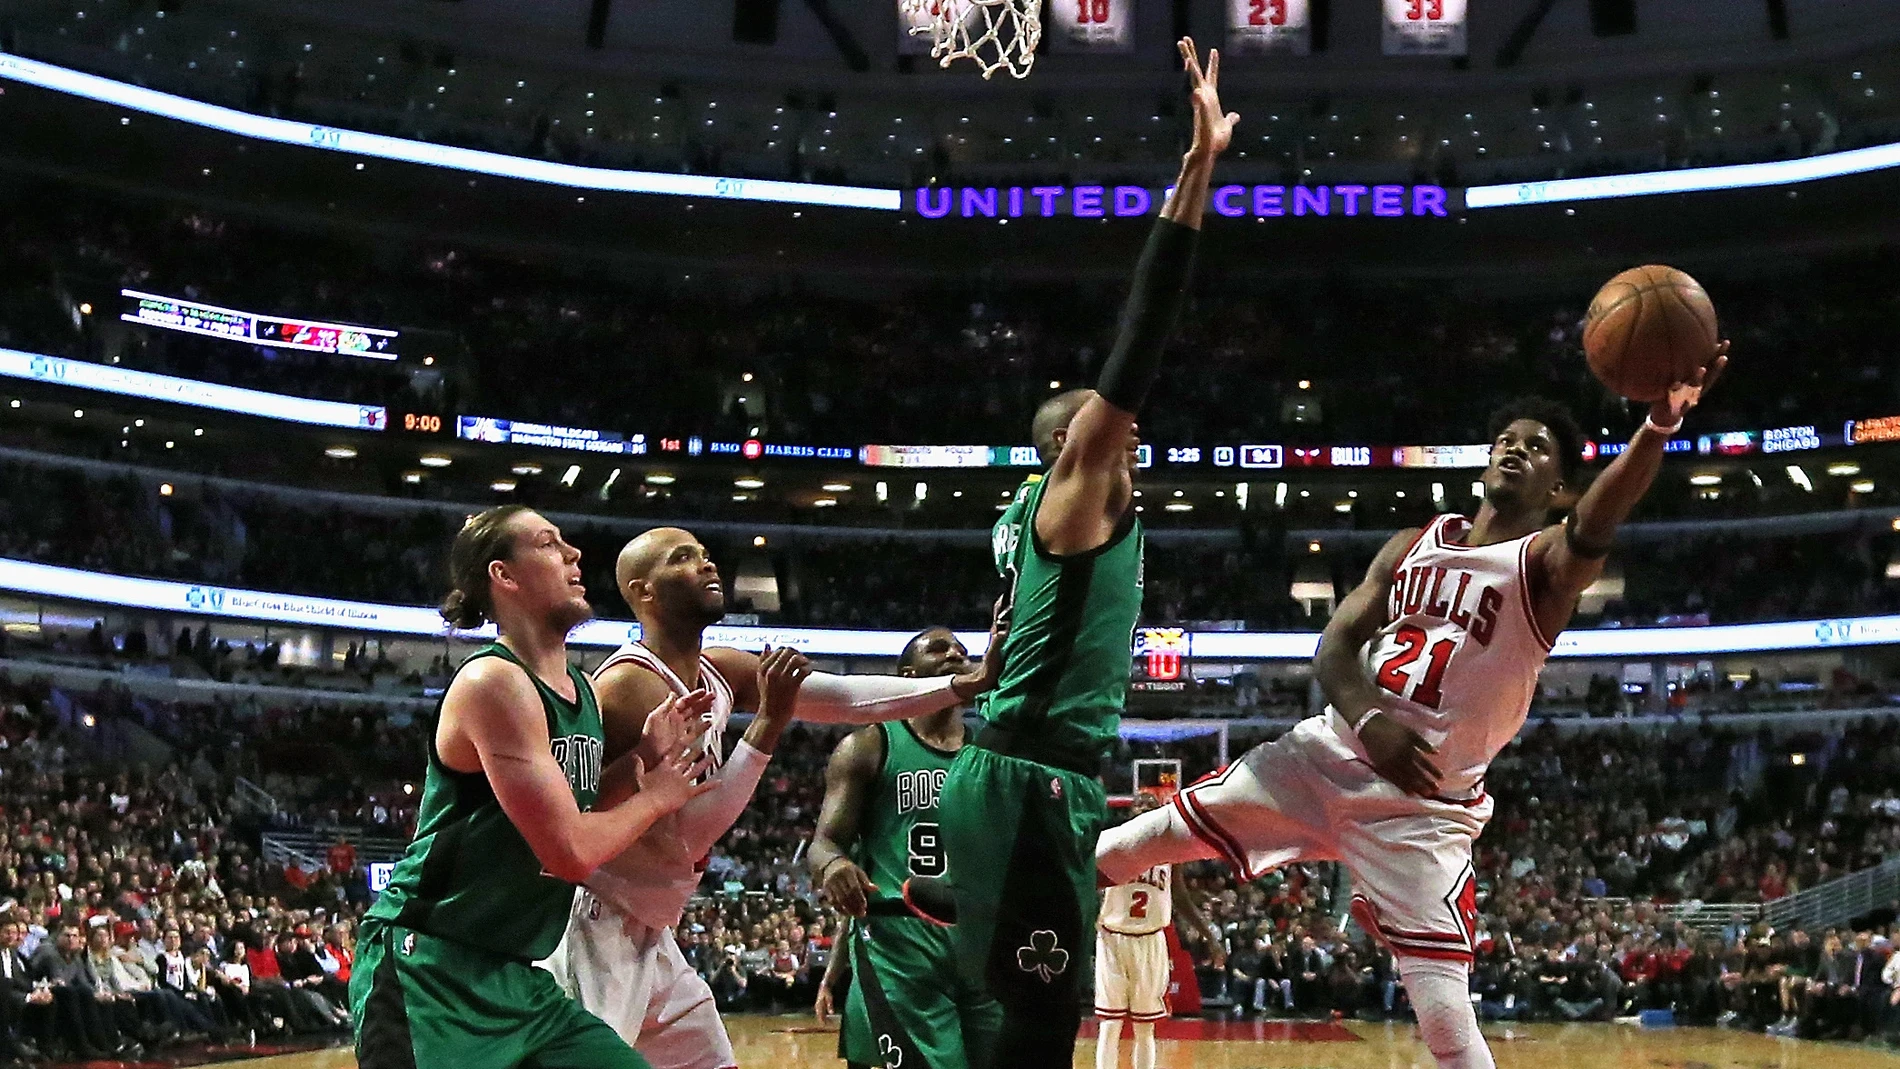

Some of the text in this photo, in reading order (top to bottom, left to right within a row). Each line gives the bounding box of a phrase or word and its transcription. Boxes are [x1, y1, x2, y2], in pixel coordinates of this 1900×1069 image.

[1077, 0, 1109, 23] 10
[1248, 0, 1287, 25] 23
[916, 185, 1448, 218] UNITED CENTER
[405, 413, 441, 432] 9:00
[1763, 426, 1815, 440] BOSTON
[660, 438, 680, 451] 1st
[711, 441, 852, 458] BMO HARRIS CLUB
[1167, 447, 1200, 463] 3:25
[1762, 436, 1820, 453] CHICAGO
[1252, 448, 1272, 463] 94
[1331, 447, 1370, 466] BULLS
[1393, 566, 1503, 648] BULLS
[1148, 650, 1180, 680] 10
[1377, 625, 1457, 710] 21
[1146, 682, 1186, 691] TISSOT
[897, 769, 948, 814] BOS
[908, 822, 948, 878] 9
[1129, 890, 1149, 918] 2
